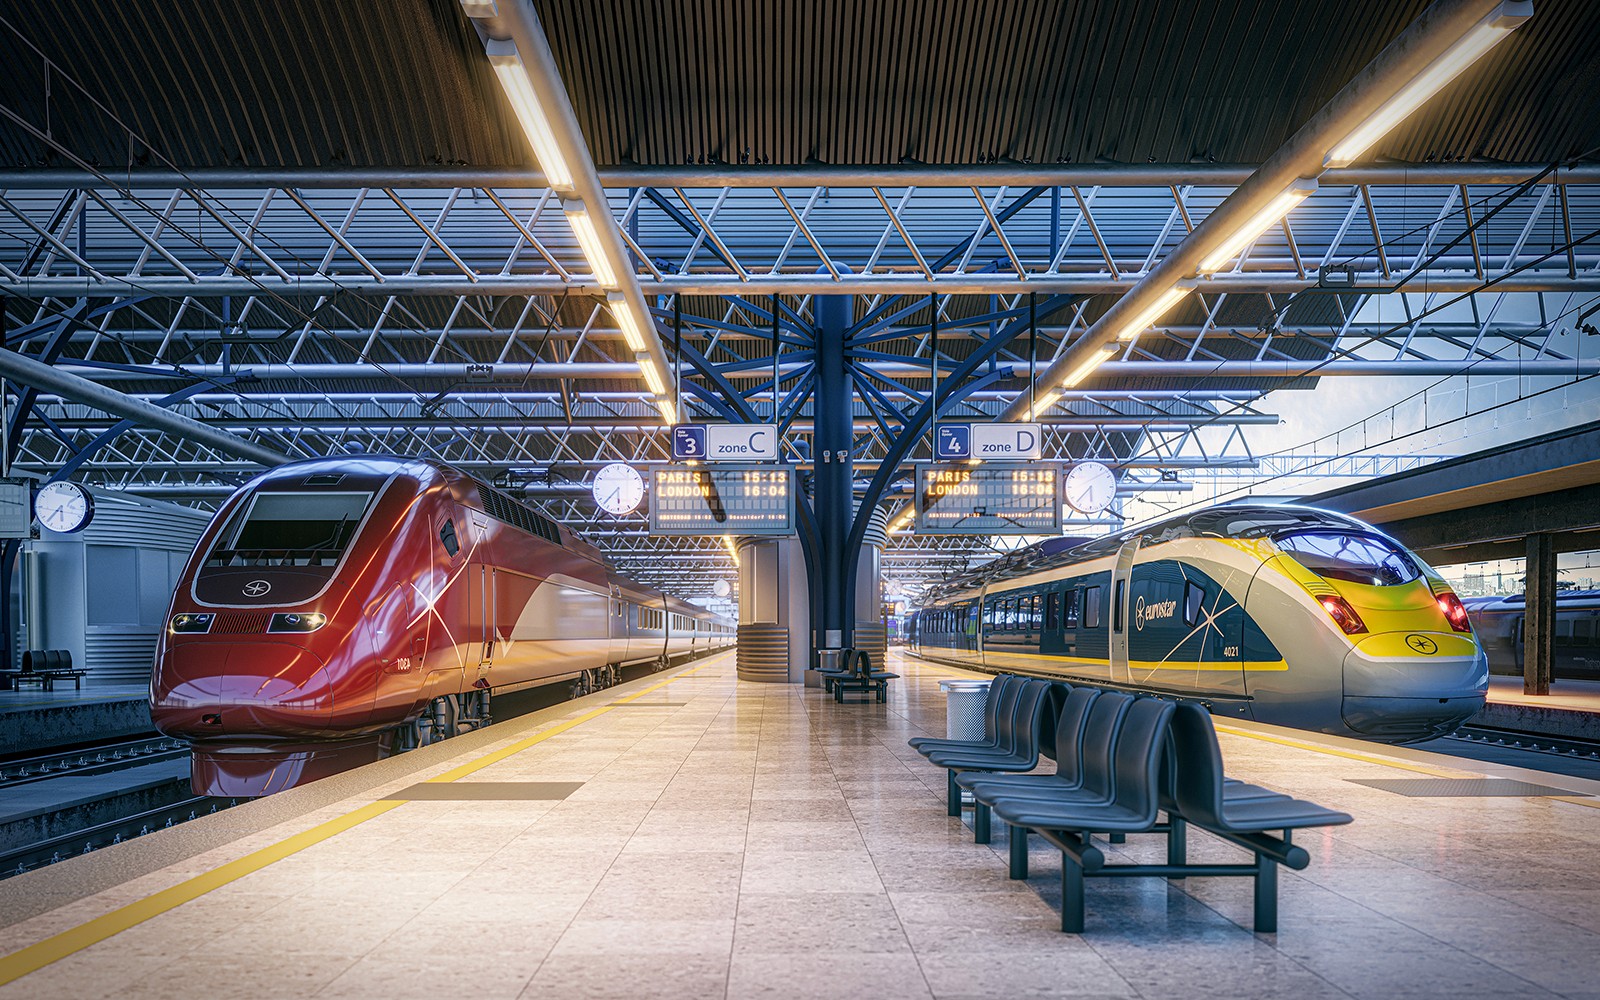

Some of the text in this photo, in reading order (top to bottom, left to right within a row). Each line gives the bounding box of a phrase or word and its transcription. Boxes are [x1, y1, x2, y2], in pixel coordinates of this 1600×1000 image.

[685, 438, 696, 454] 3
[718, 431, 765, 453] zone C
[948, 437, 961, 453] 4
[982, 430, 1035, 452] zone D
[658, 472, 786, 483] PARIS 15:13
[928, 471, 1053, 482] PARIS 15:13
[658, 486, 786, 497] LONDON 16:04
[928, 485, 978, 496] LONDON
[1145, 599, 1177, 620] eurostar
[1223, 646, 1239, 657] 4021
